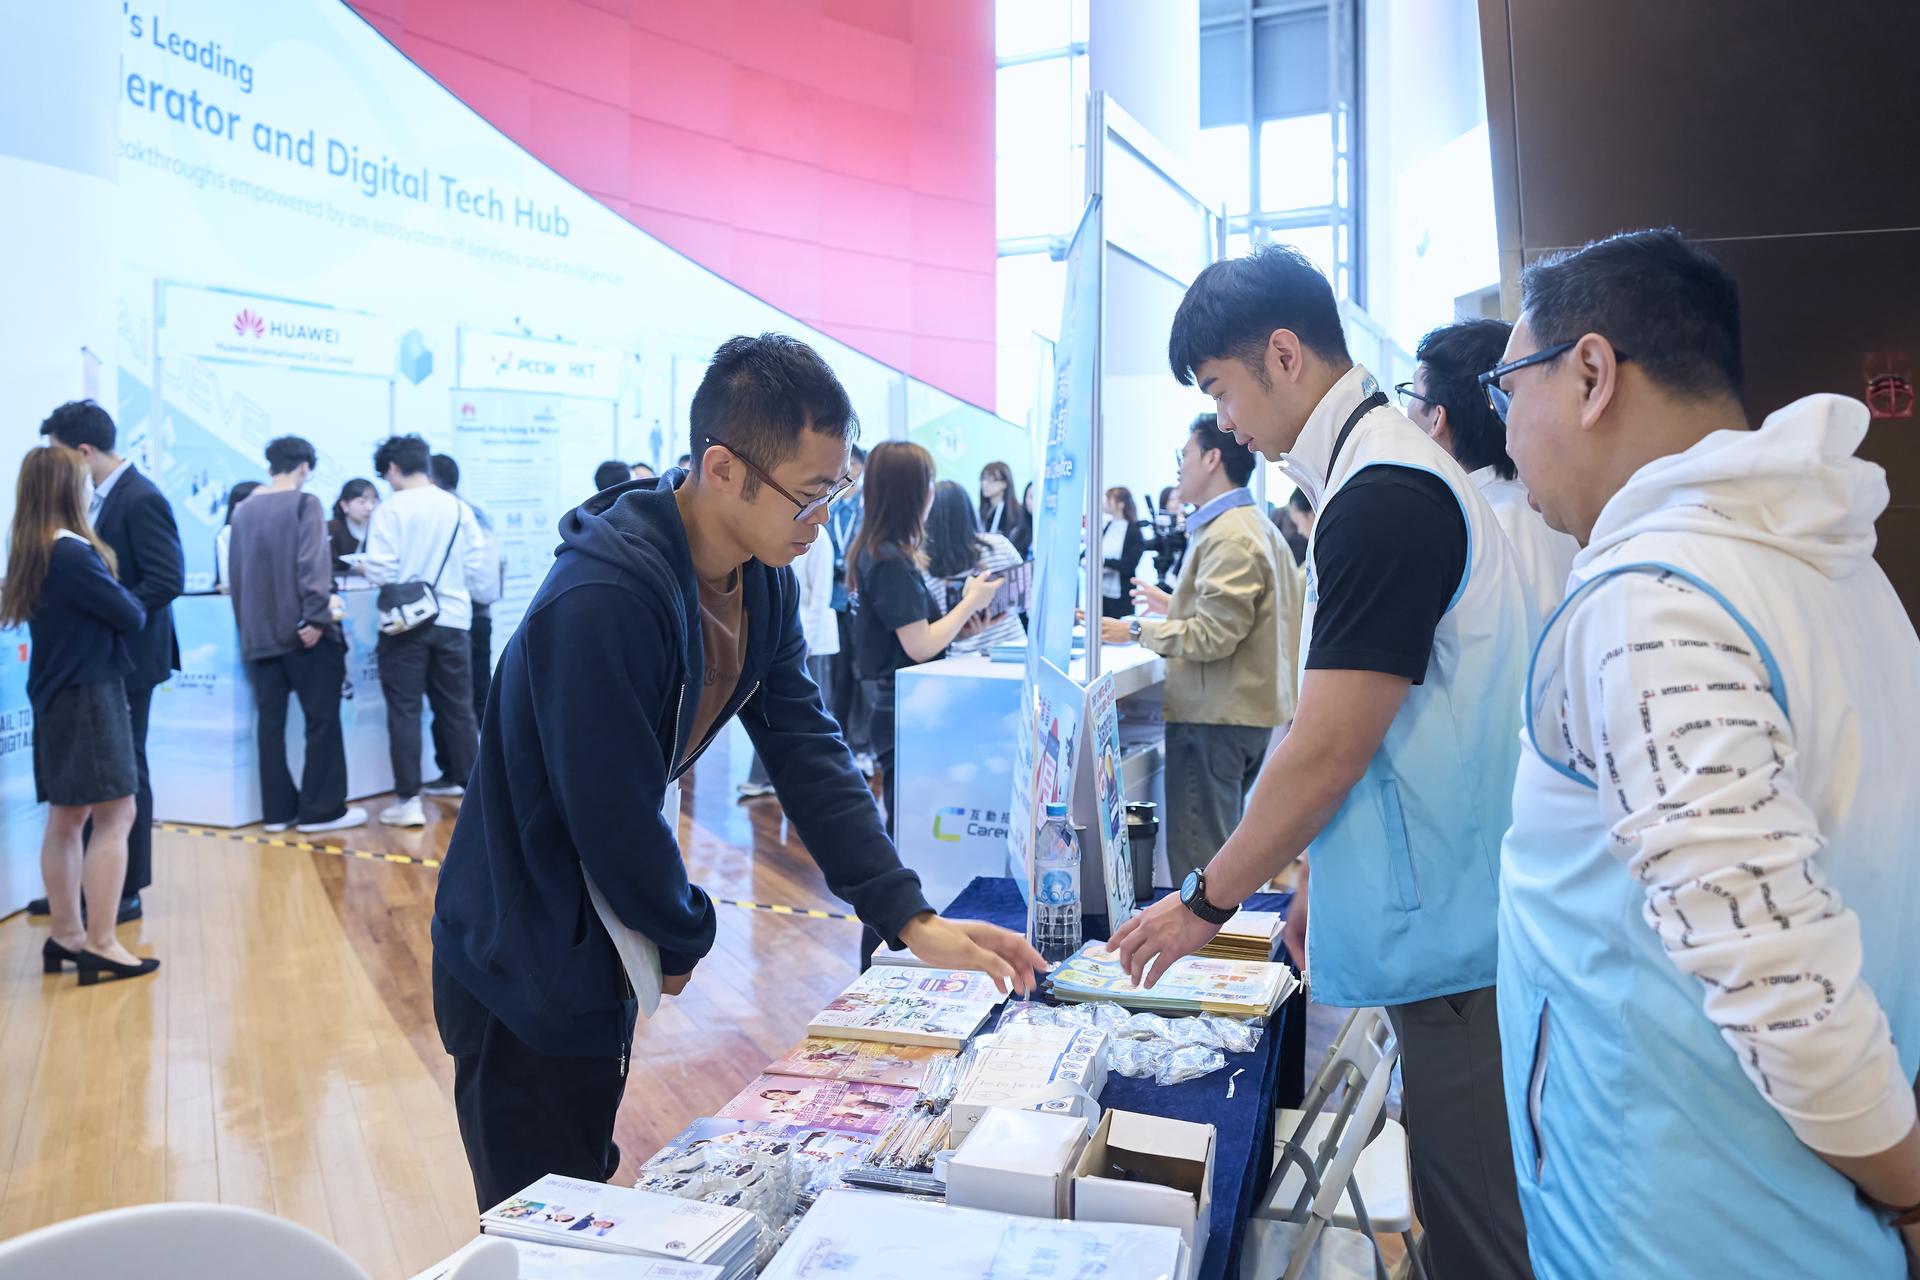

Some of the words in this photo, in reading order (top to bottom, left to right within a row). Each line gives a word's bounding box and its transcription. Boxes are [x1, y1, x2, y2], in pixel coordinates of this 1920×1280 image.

[153, 16, 253, 94] Leading
[252, 119, 315, 168] and
[328, 138, 428, 203] Digital
[439, 174, 503, 223] Tech
[515, 196, 570, 238] Hub
[270, 320, 340, 345] HUAWEI
[518, 359, 557, 375] PCCW
[568, 362, 595, 379] HKT
